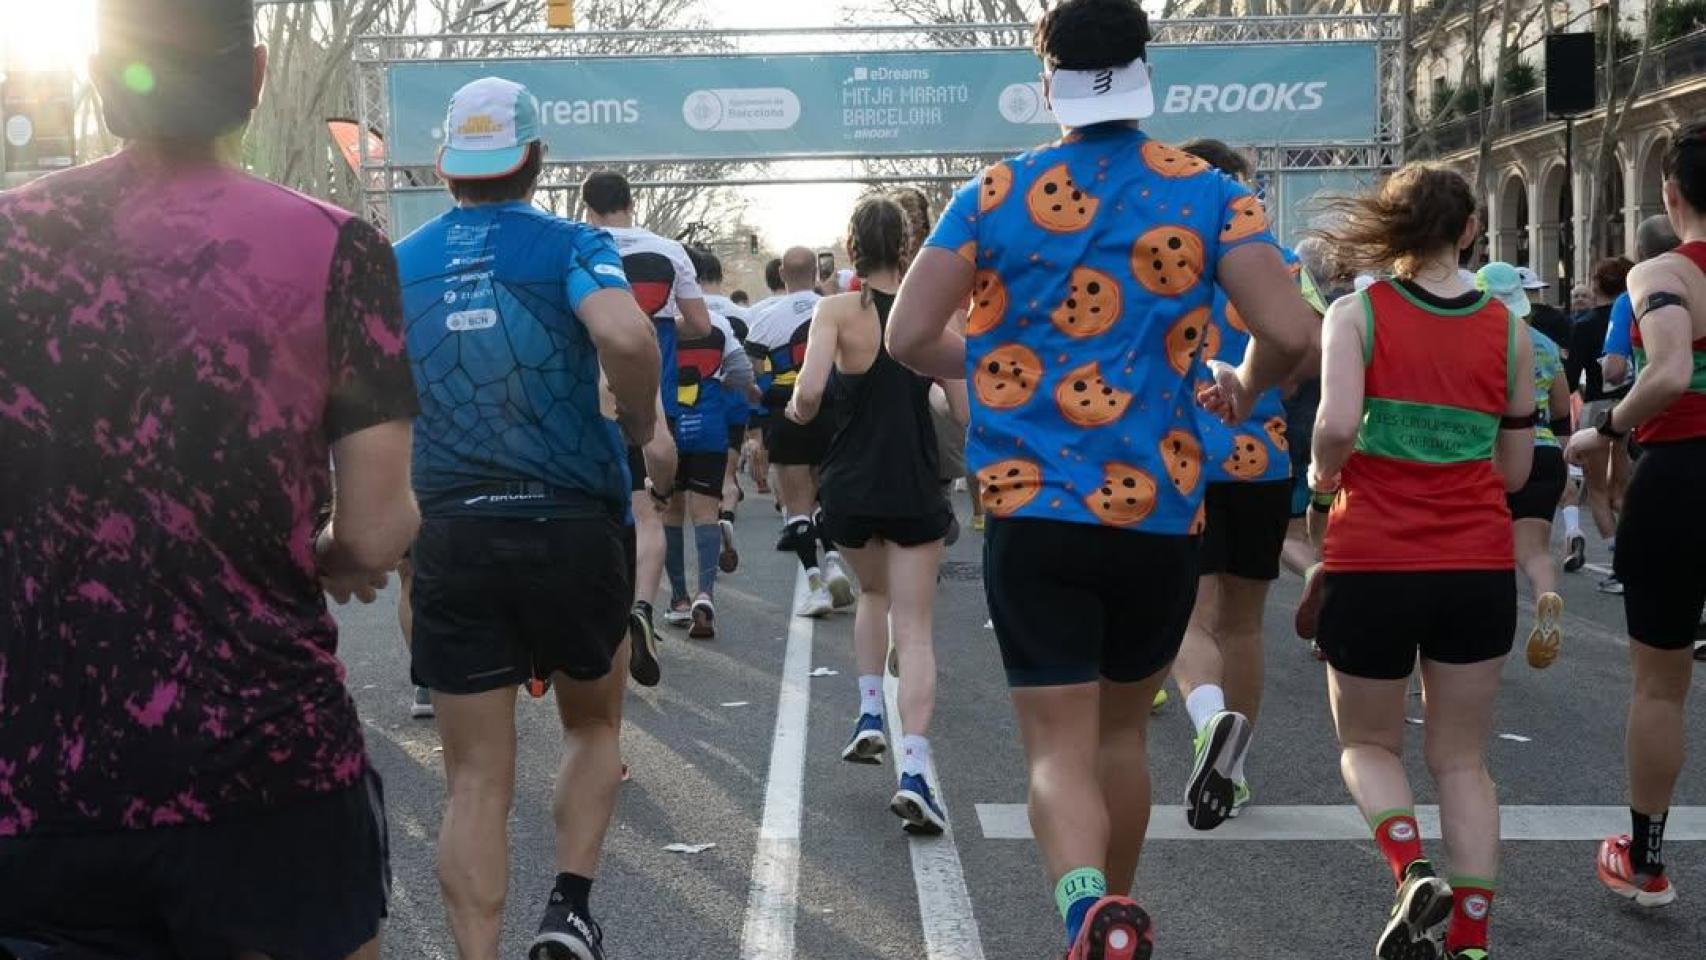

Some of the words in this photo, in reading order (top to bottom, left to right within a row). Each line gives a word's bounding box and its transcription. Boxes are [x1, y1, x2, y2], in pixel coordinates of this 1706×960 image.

[870, 67, 930, 80] eDreams
[842, 86, 894, 105] MITJA
[1162, 81, 1328, 113] BROOKS
[538, 97, 641, 127] reams
[842, 107, 943, 127] BARCELONA
